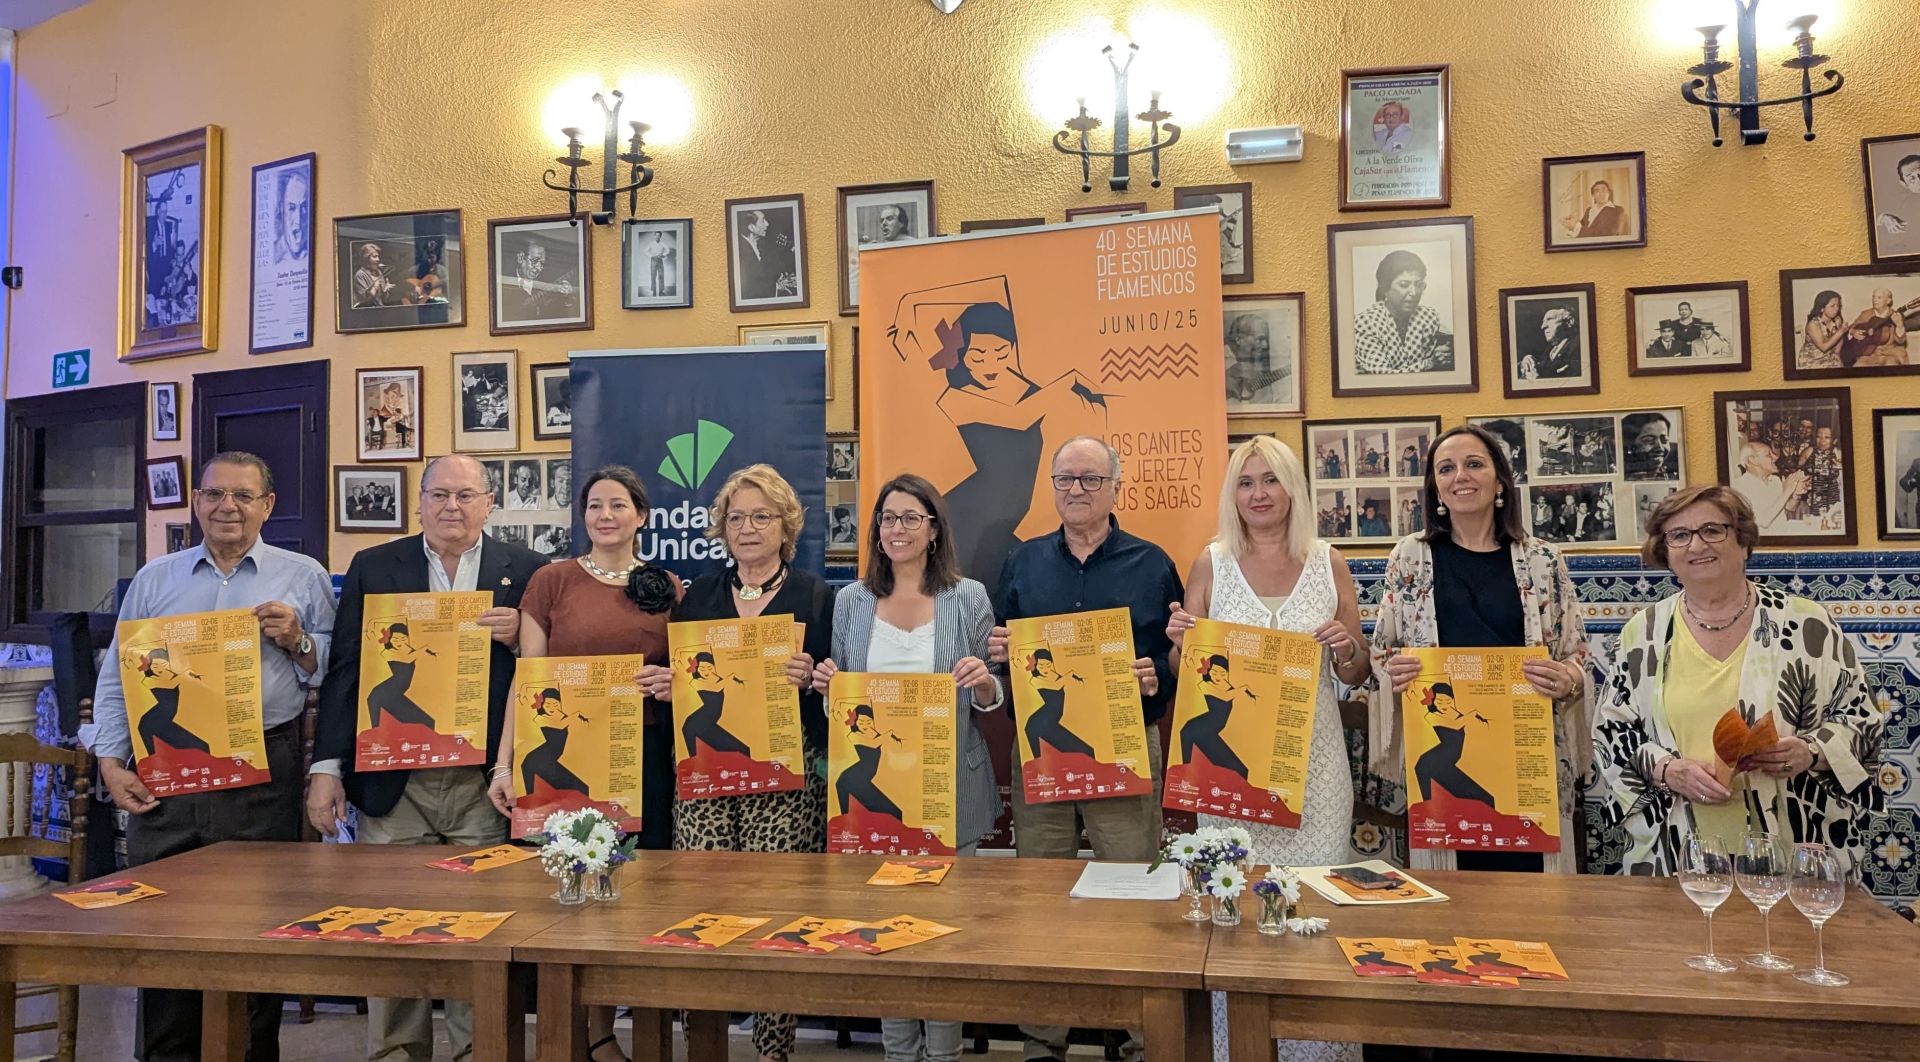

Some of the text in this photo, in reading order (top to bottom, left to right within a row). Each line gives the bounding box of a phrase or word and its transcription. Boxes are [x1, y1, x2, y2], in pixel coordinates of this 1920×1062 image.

[1126, 222, 1192, 249] SEMANA
[1097, 246, 1197, 276] DE ESTUDIOS
[1098, 271, 1196, 301] FLAMENCOS
[1103, 429, 1202, 456] OS CANTES
[1132, 458, 1188, 484] JEREZ
[1194, 456, 1204, 480] Y
[1116, 484, 1202, 512] US SAGAS
[1239, 630, 1260, 640] SEMANA
[1224, 637, 1260, 649] DE ESTUDIOS
[1286, 639, 1317, 650] LOS CANTES
[1264, 644, 1280, 652] JUNIO
[1263, 652, 1278, 660] 2025
[1294, 648, 1312, 657] JEREZ
[1284, 654, 1315, 666] SUS SAGAS
[1458, 654, 1482, 664] SEMANA
[1486, 655, 1504, 663] 02-06
[1522, 654, 1543, 662] CANTES
[1444, 664, 1482, 672] DE ESTUDIOS
[1486, 664, 1504, 672] JUNIO
[1488, 672, 1502, 680] 2025
[1510, 672, 1522, 680] SUS
[922, 680, 952, 688] LOS CANTES
[903, 688, 918, 696] JUNIO
[922, 688, 930, 696] DE
[931, 688, 947, 696] JEREZ
[904, 696, 916, 704] 2025
[922, 696, 950, 704] SUS SAGAS
